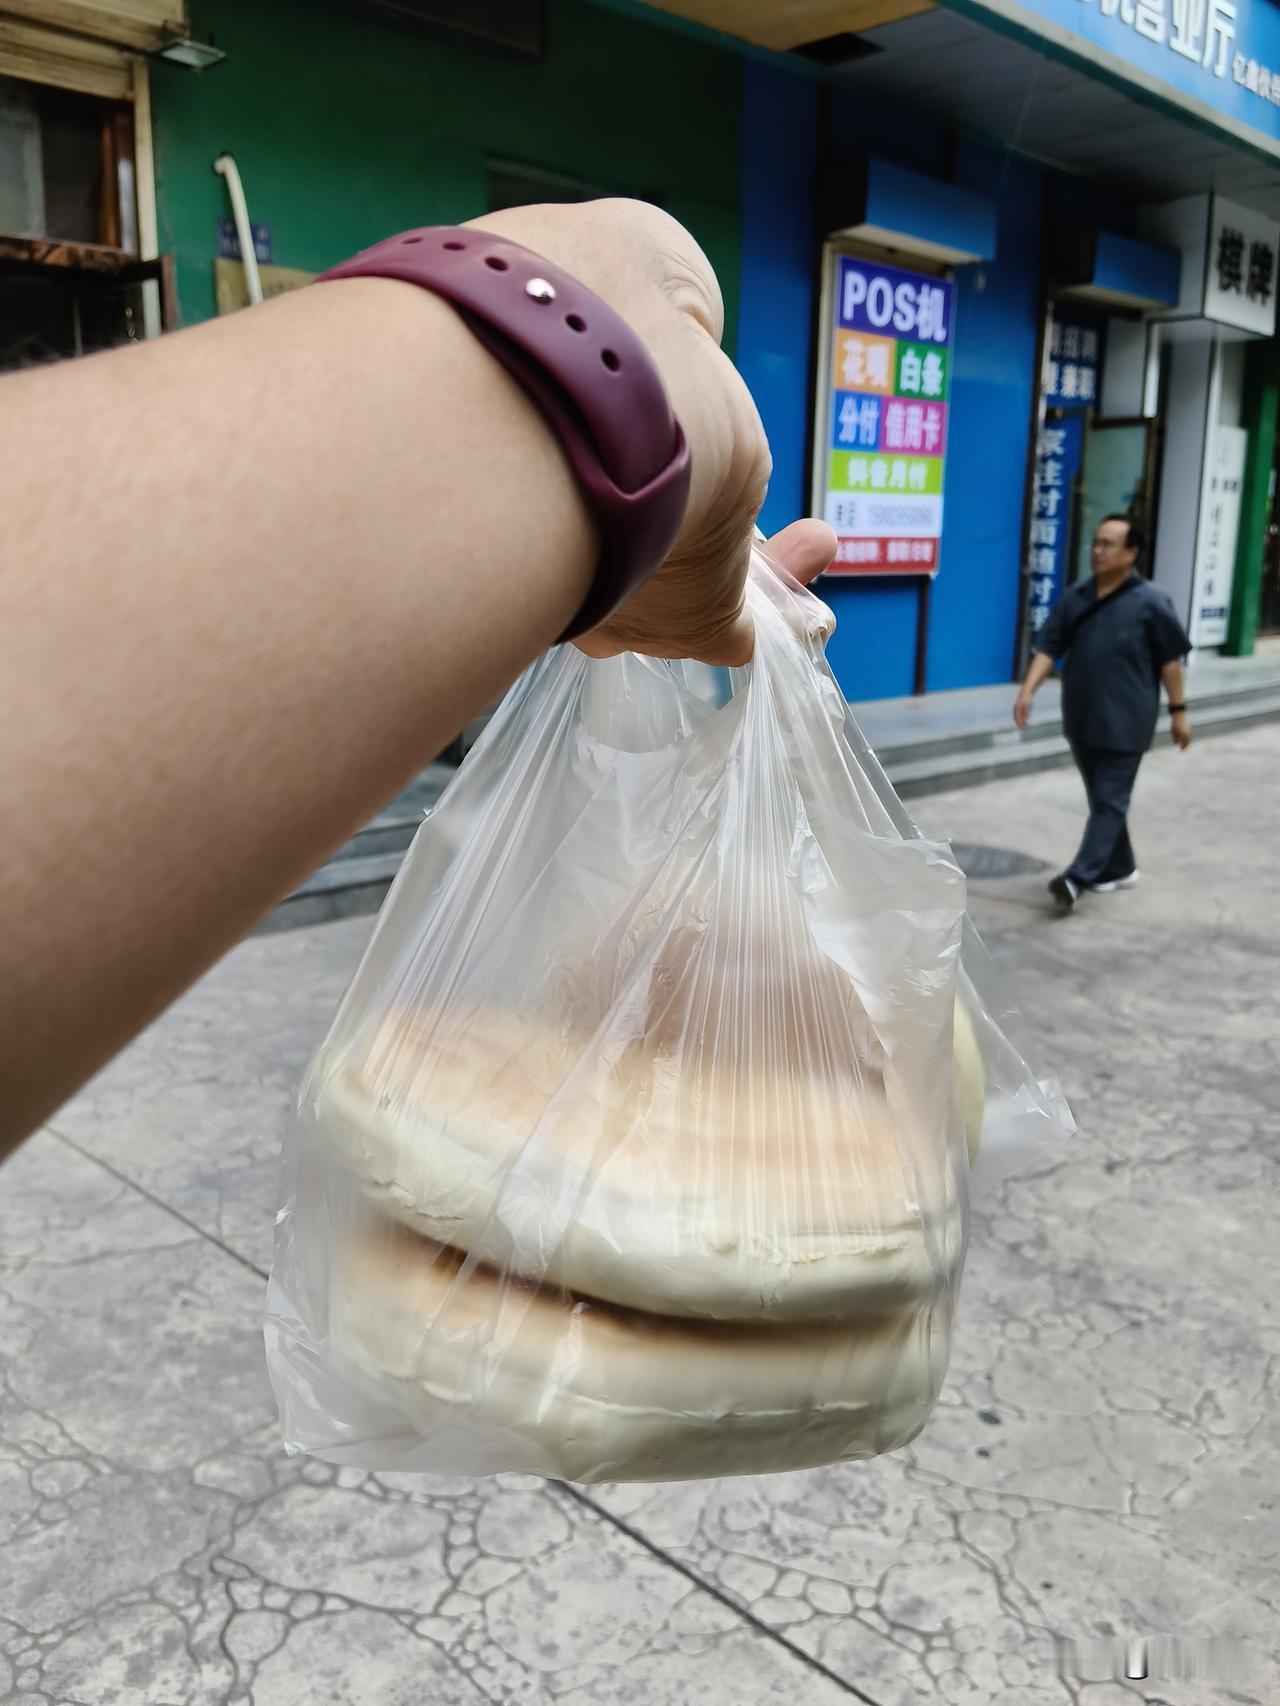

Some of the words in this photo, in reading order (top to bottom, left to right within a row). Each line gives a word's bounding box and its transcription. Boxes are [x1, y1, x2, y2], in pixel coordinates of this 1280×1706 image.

[842, 270, 948, 343] POS机
[899, 347, 945, 397] 白条
[885, 400, 942, 451] 信用卡
